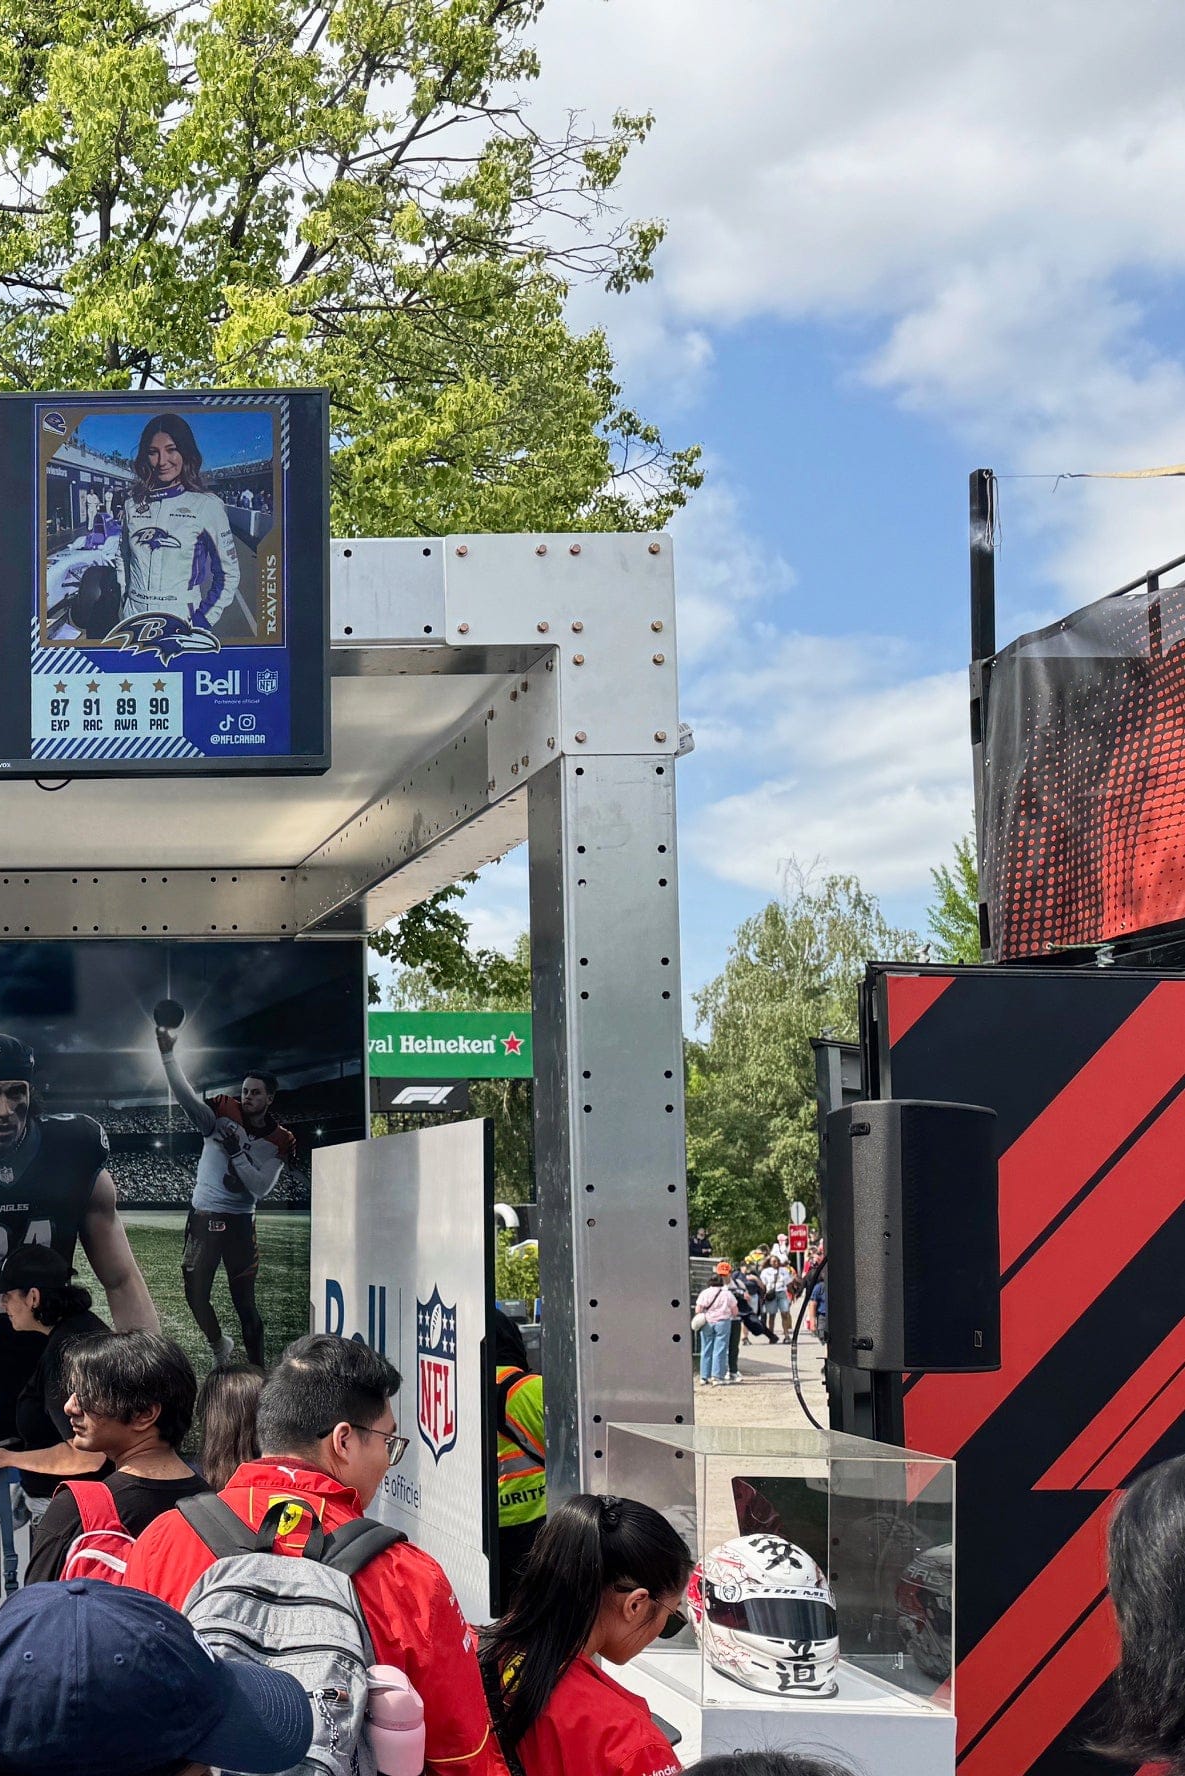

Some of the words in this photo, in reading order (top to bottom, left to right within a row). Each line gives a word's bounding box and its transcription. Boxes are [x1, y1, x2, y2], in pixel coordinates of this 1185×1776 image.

[267, 554, 277, 636] RAVENS
[195, 670, 241, 696] Bell
[50, 699, 70, 717] 87
[82, 698, 101, 716] 91
[116, 698, 137, 716] 89
[149, 698, 170, 715] 90
[51, 720, 70, 732] EXP
[83, 719, 103, 731] RAC
[114, 719, 138, 731] AWA
[149, 718, 169, 730] PAC
[210, 734, 266, 745] @NFLCANADA
[399, 1034, 496, 1054] Heineken
[325, 1278, 386, 1357] Bll
[420, 1359, 454, 1445] NFL
[391, 1475, 422, 1510] officiel
